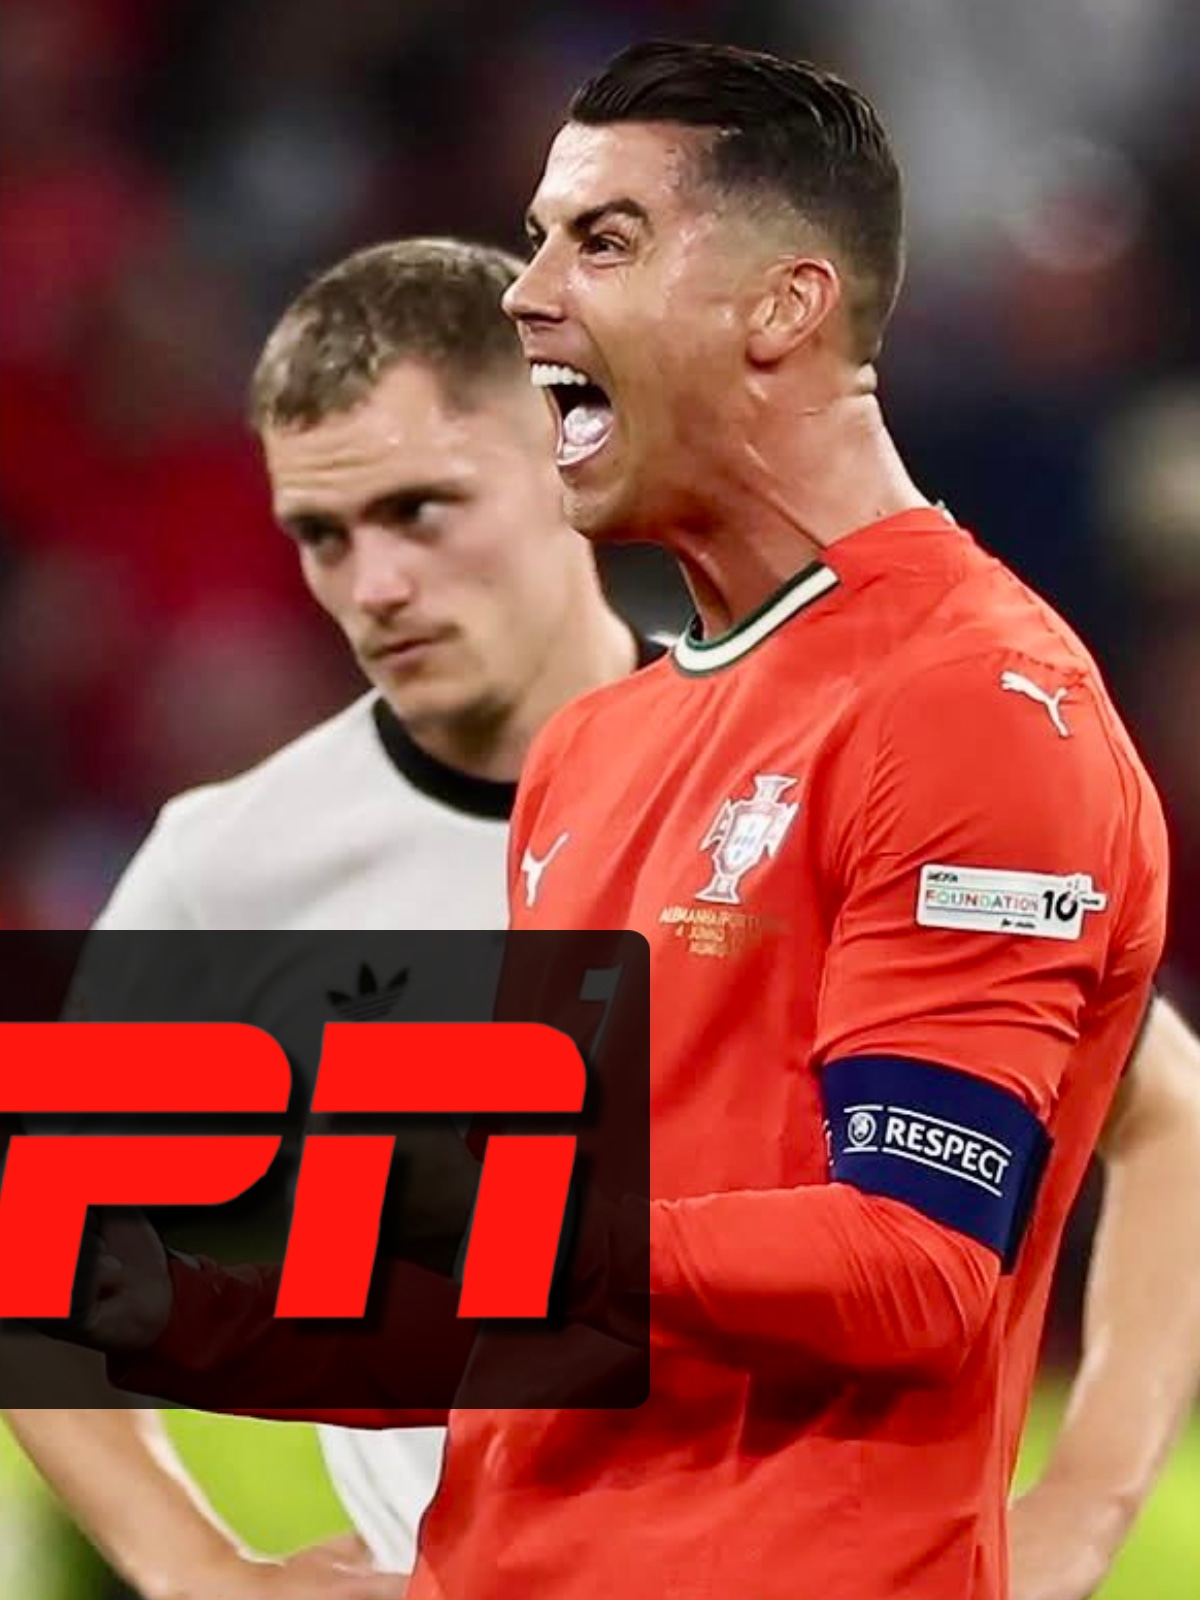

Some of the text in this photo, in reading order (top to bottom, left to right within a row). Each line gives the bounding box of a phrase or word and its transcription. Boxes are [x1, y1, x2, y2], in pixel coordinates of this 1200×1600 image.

[926, 888, 1039, 912] FOUNDATION
[1042, 889, 1078, 922] 10
[884, 1116, 1010, 1184] RESPECT
